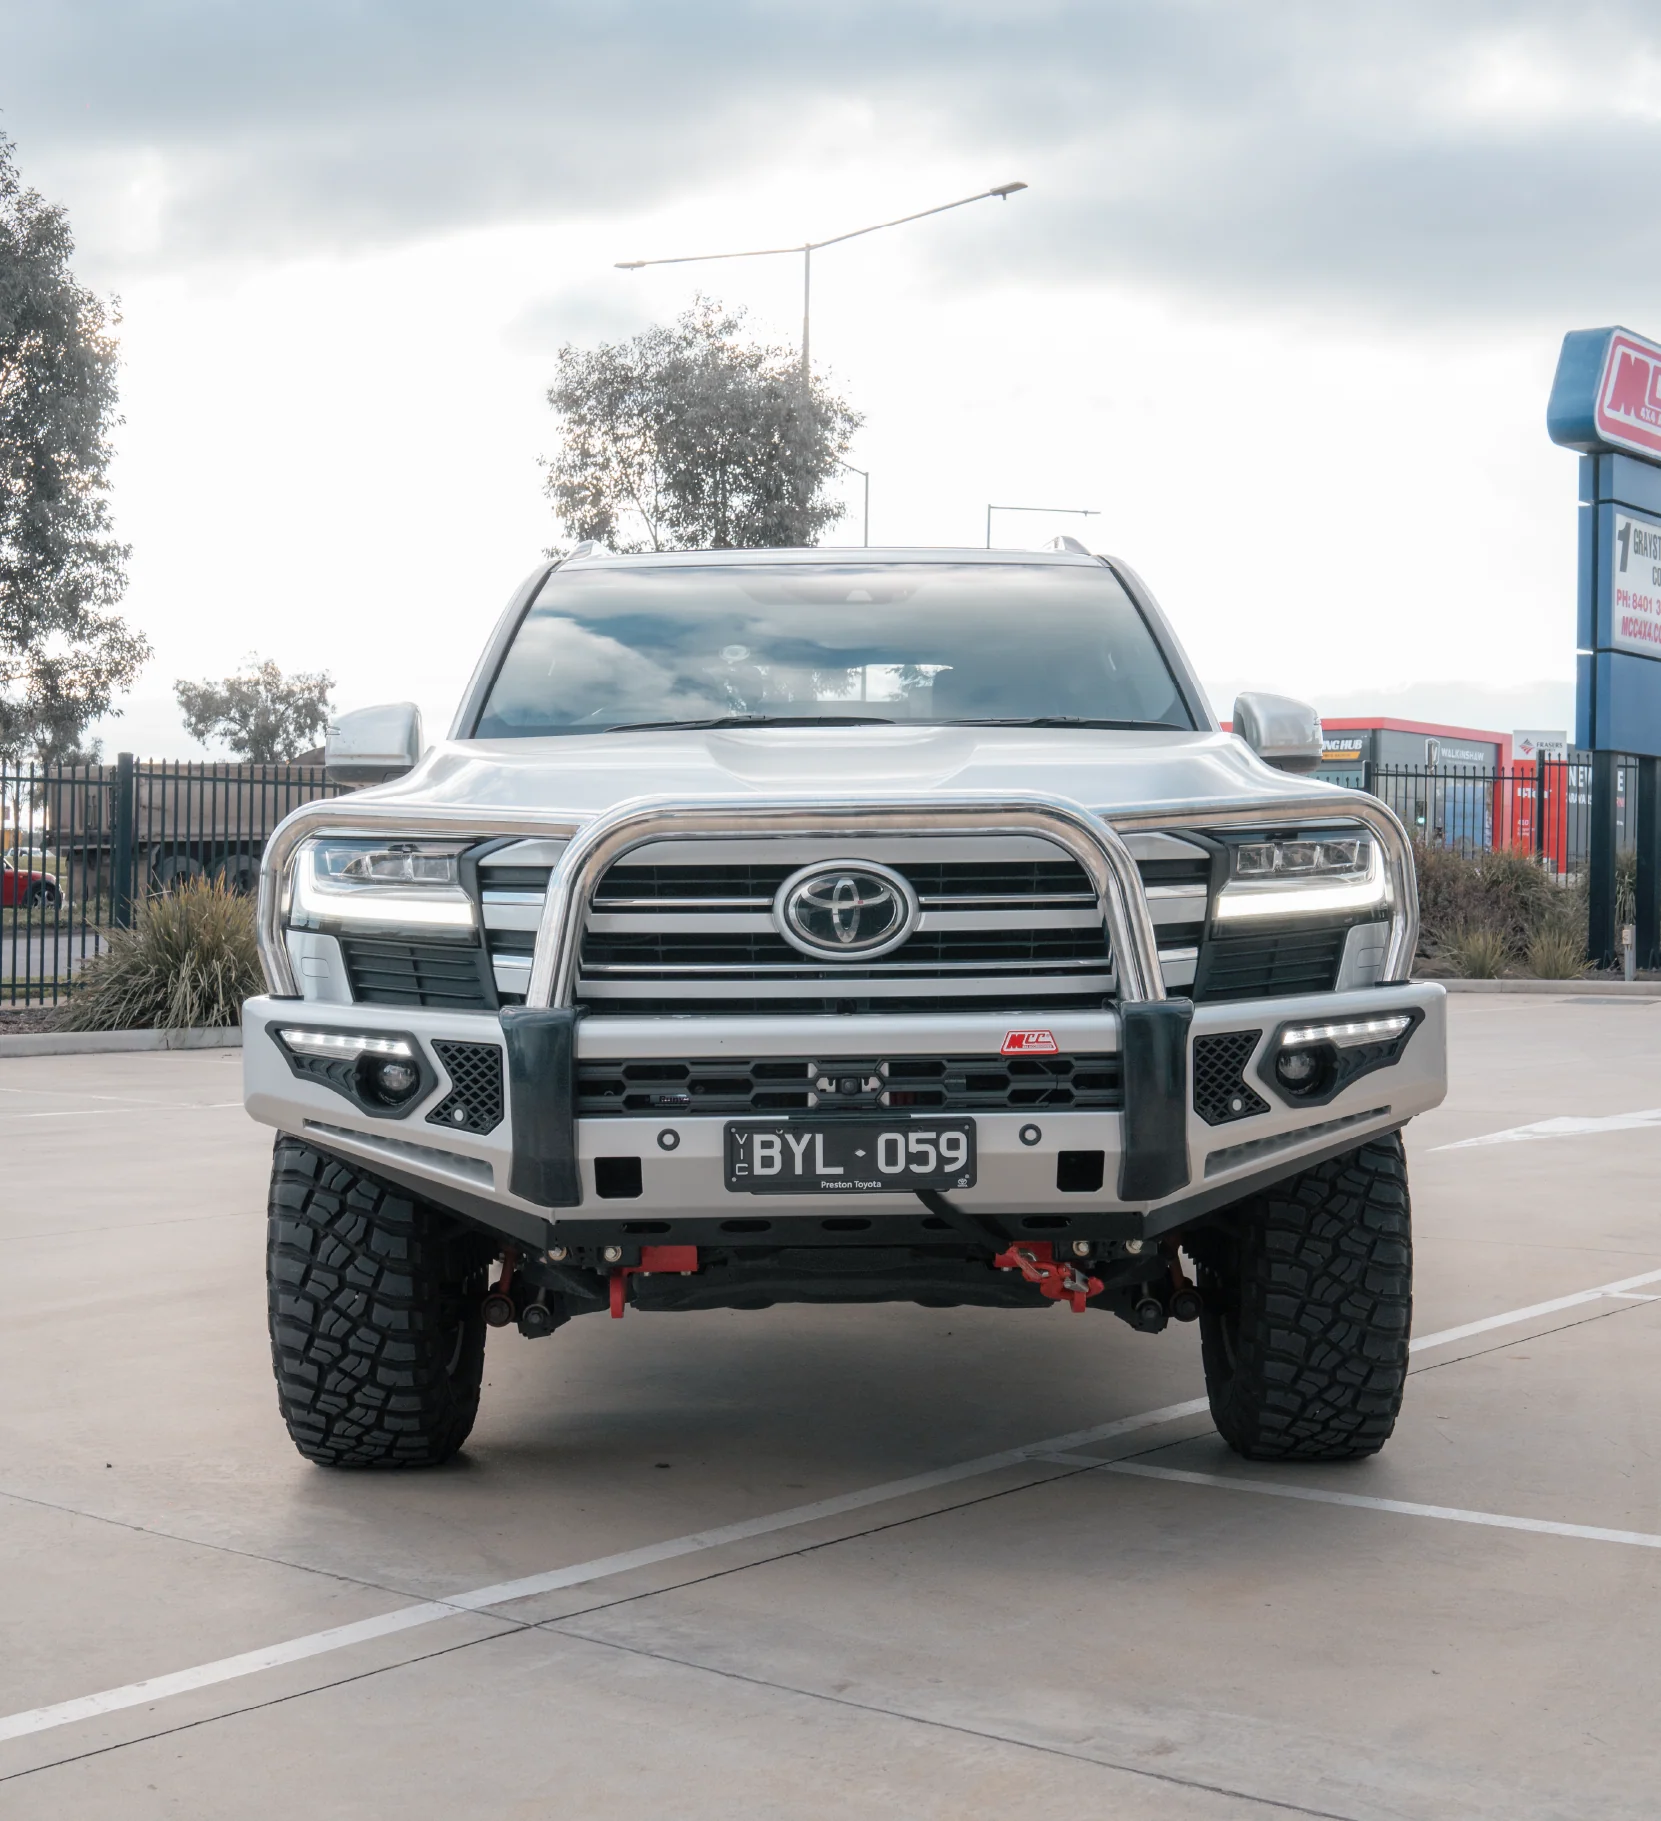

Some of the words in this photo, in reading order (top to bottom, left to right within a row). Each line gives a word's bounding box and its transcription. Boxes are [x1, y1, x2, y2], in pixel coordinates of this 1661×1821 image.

[1617, 521, 1631, 572] 1
[1616, 588, 1630, 608] PH:
[1632, 593, 1653, 613] 8401
[1340, 739, 1362, 750] HUB
[1441, 747, 1485, 761] WALKINSHAW
[1006, 1033, 1052, 1049] MCC
[735, 1133, 749, 1175] VIC
[753, 1133, 844, 1176] BYL
[877, 1131, 968, 1174] 059
[821, 1180, 853, 1189] Preston
[854, 1180, 882, 1190] Toyota
